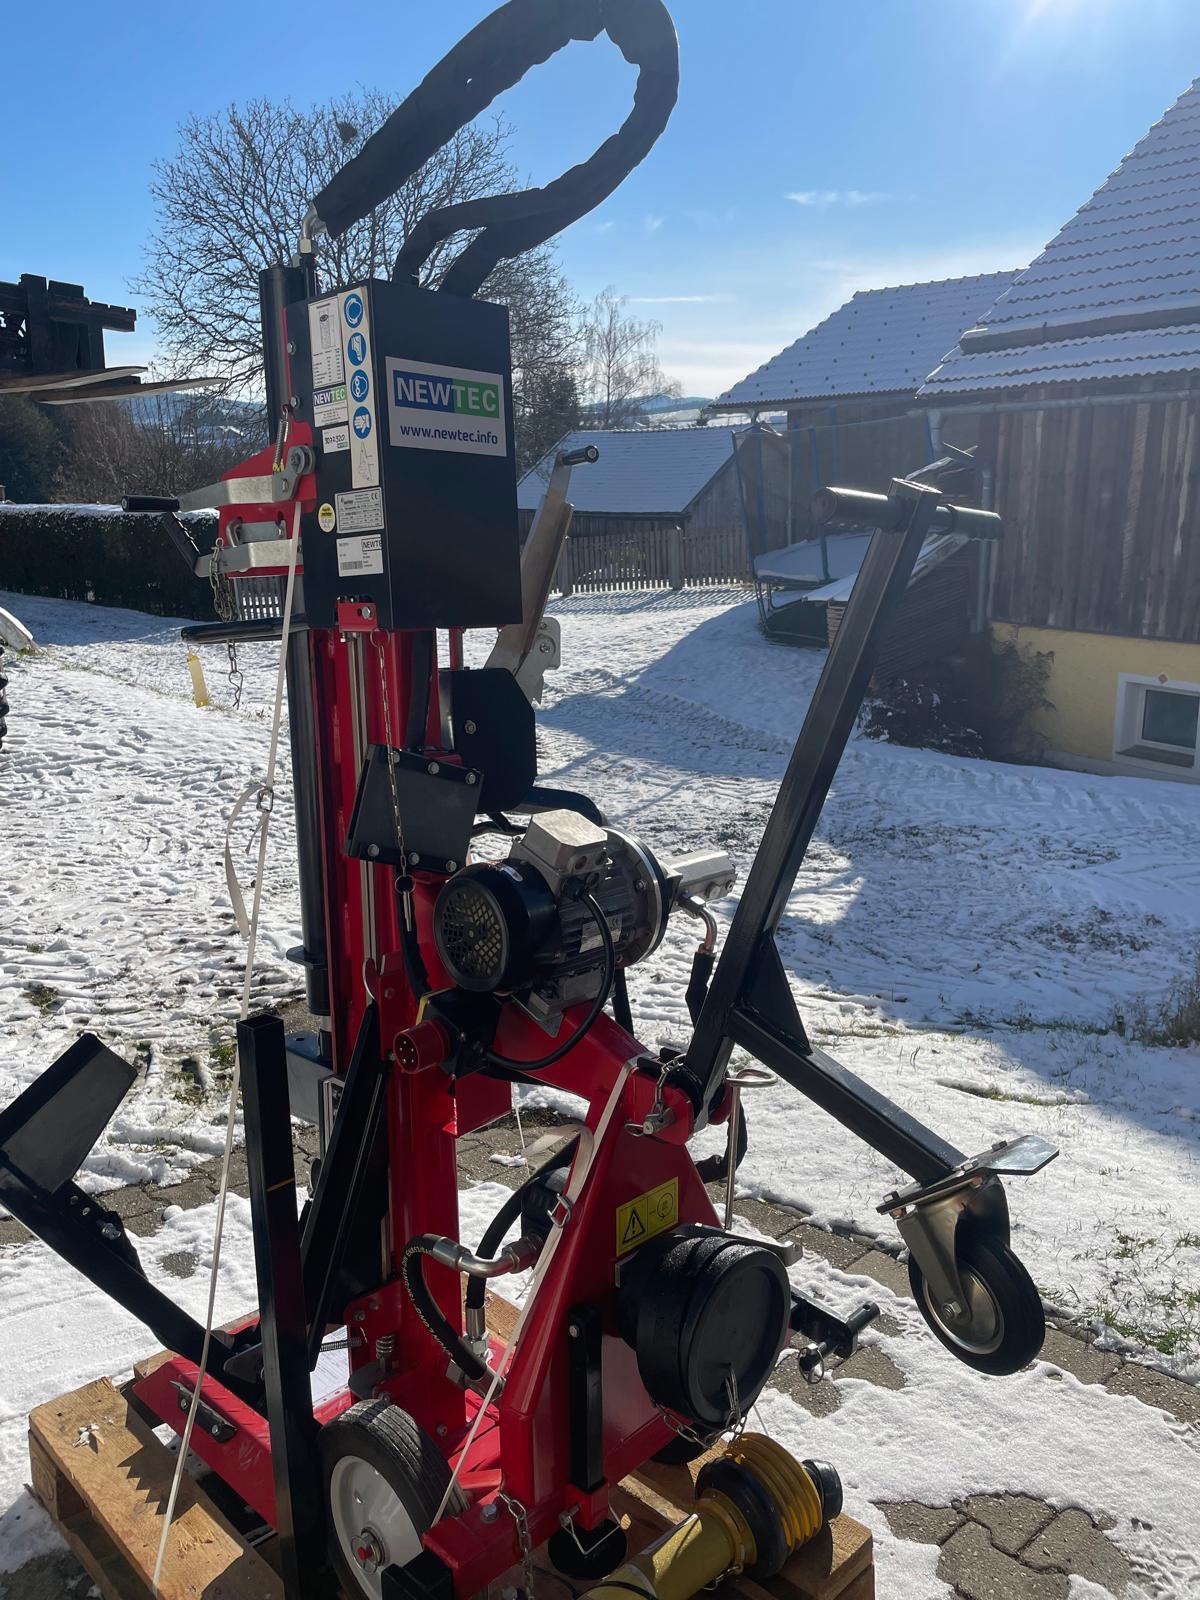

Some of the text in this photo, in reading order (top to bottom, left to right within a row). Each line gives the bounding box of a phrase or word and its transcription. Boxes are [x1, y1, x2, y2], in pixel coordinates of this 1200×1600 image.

[314, 389, 345, 406] NEWTEC
[396, 377, 497, 412] NEWTEC
[400, 425, 498, 445] www.newtec.info
